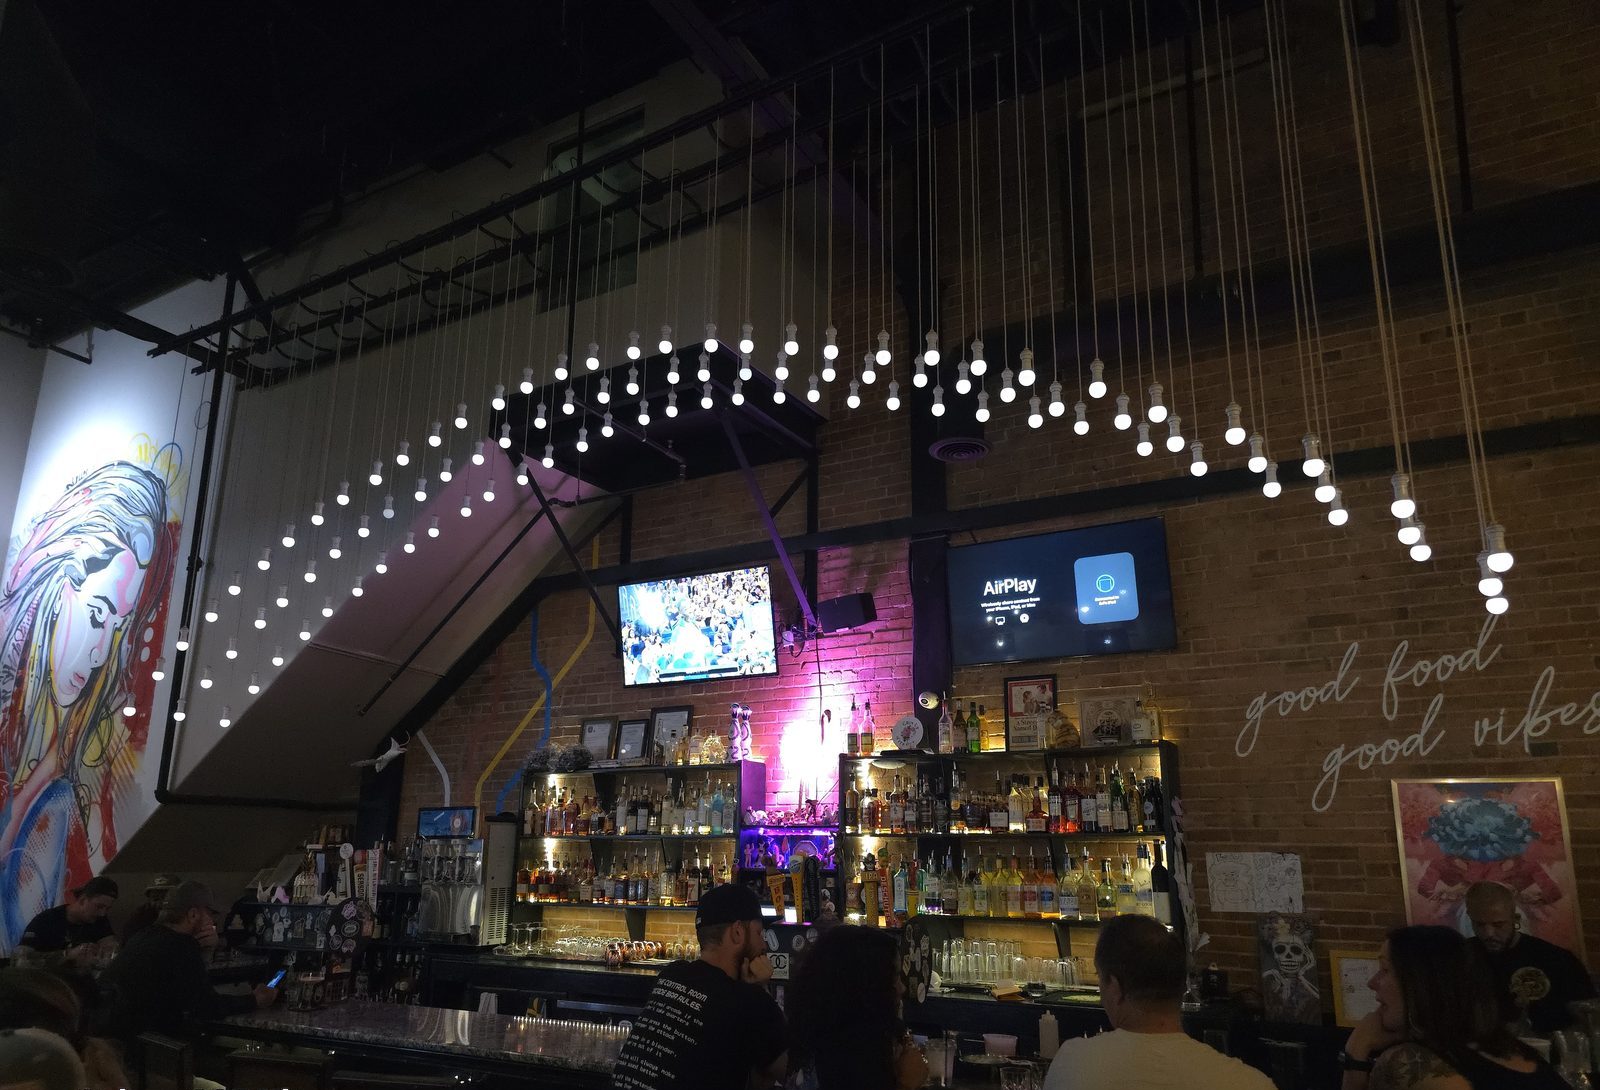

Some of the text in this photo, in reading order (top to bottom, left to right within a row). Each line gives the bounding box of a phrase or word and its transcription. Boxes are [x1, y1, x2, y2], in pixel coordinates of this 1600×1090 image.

[983, 578, 1037, 596] AirPlay
[1235, 613, 1503, 758] good food
[1311, 666, 1600, 812] good vibes
[663, 979, 687, 994] CONTROL
[687, 988, 708, 1002] ROOM
[665, 990, 679, 1001] BAR
